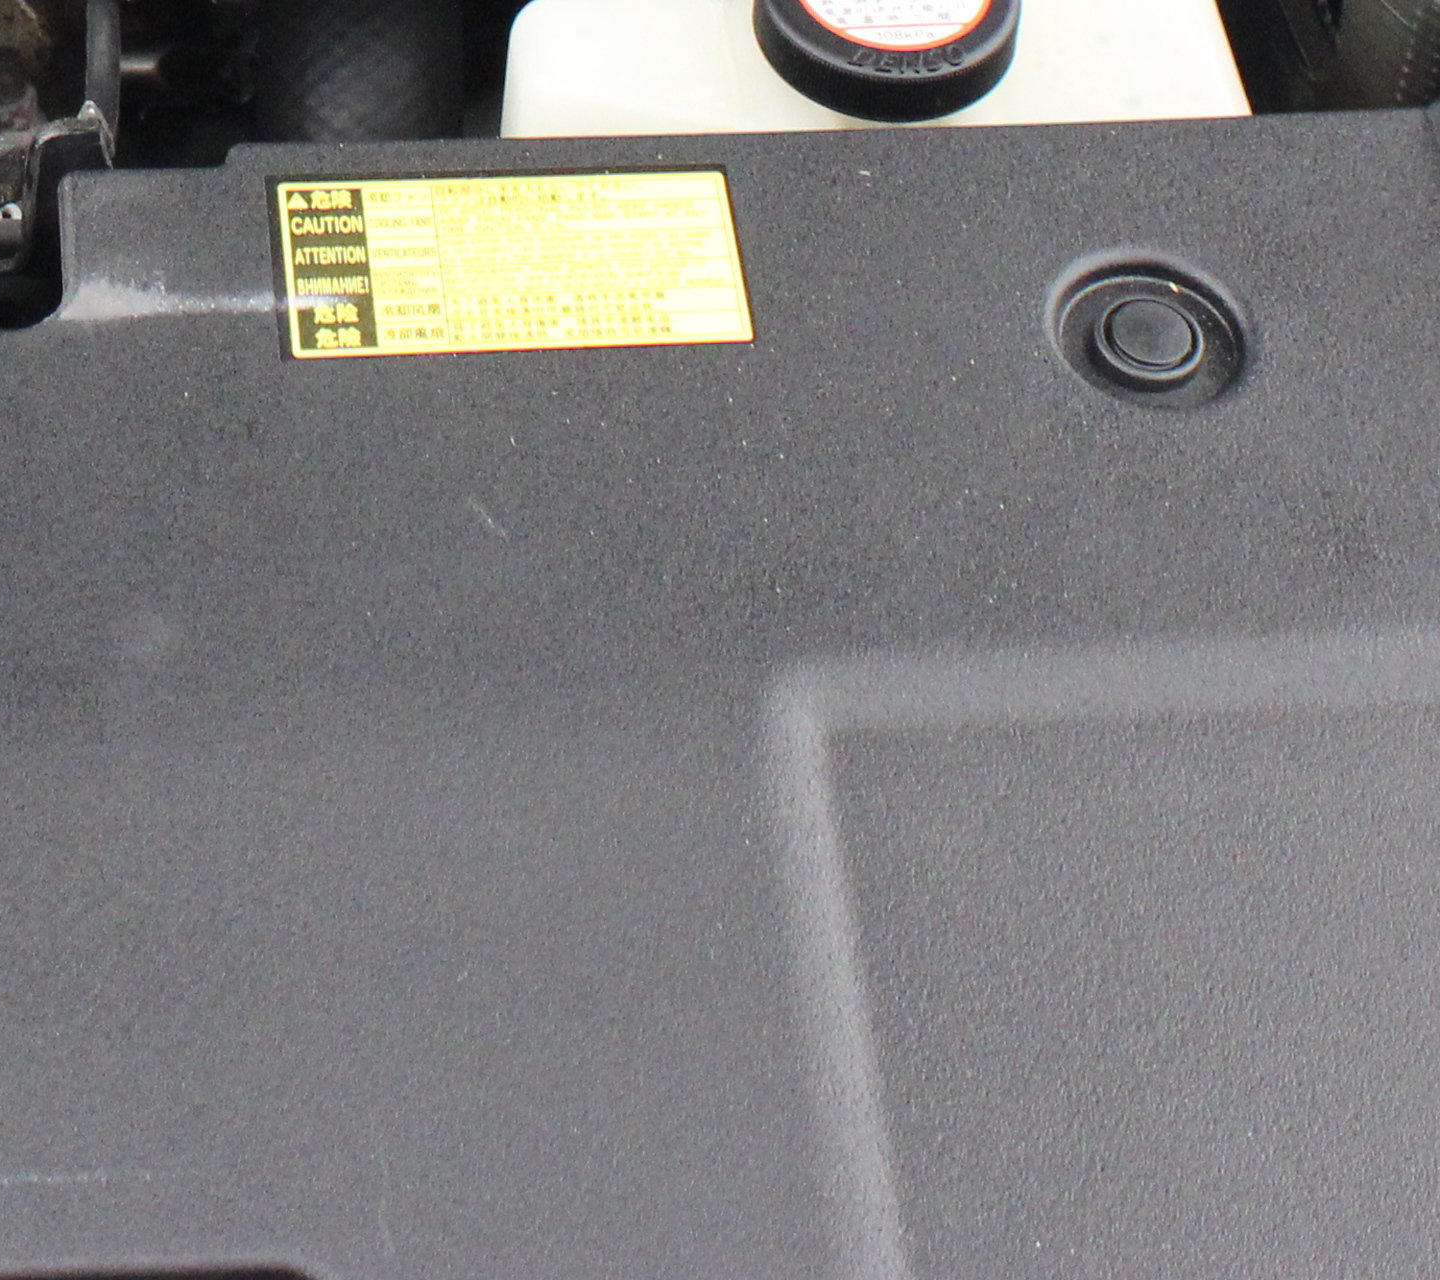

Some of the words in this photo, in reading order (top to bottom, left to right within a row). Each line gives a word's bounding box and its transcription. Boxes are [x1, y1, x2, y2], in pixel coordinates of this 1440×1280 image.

[847, 45, 966, 75] DENSO
[291, 215, 363, 236] CAUTION
[295, 246, 367, 265] ATTENTION
[296, 275, 370, 296] ВНИМАНИЕ!
